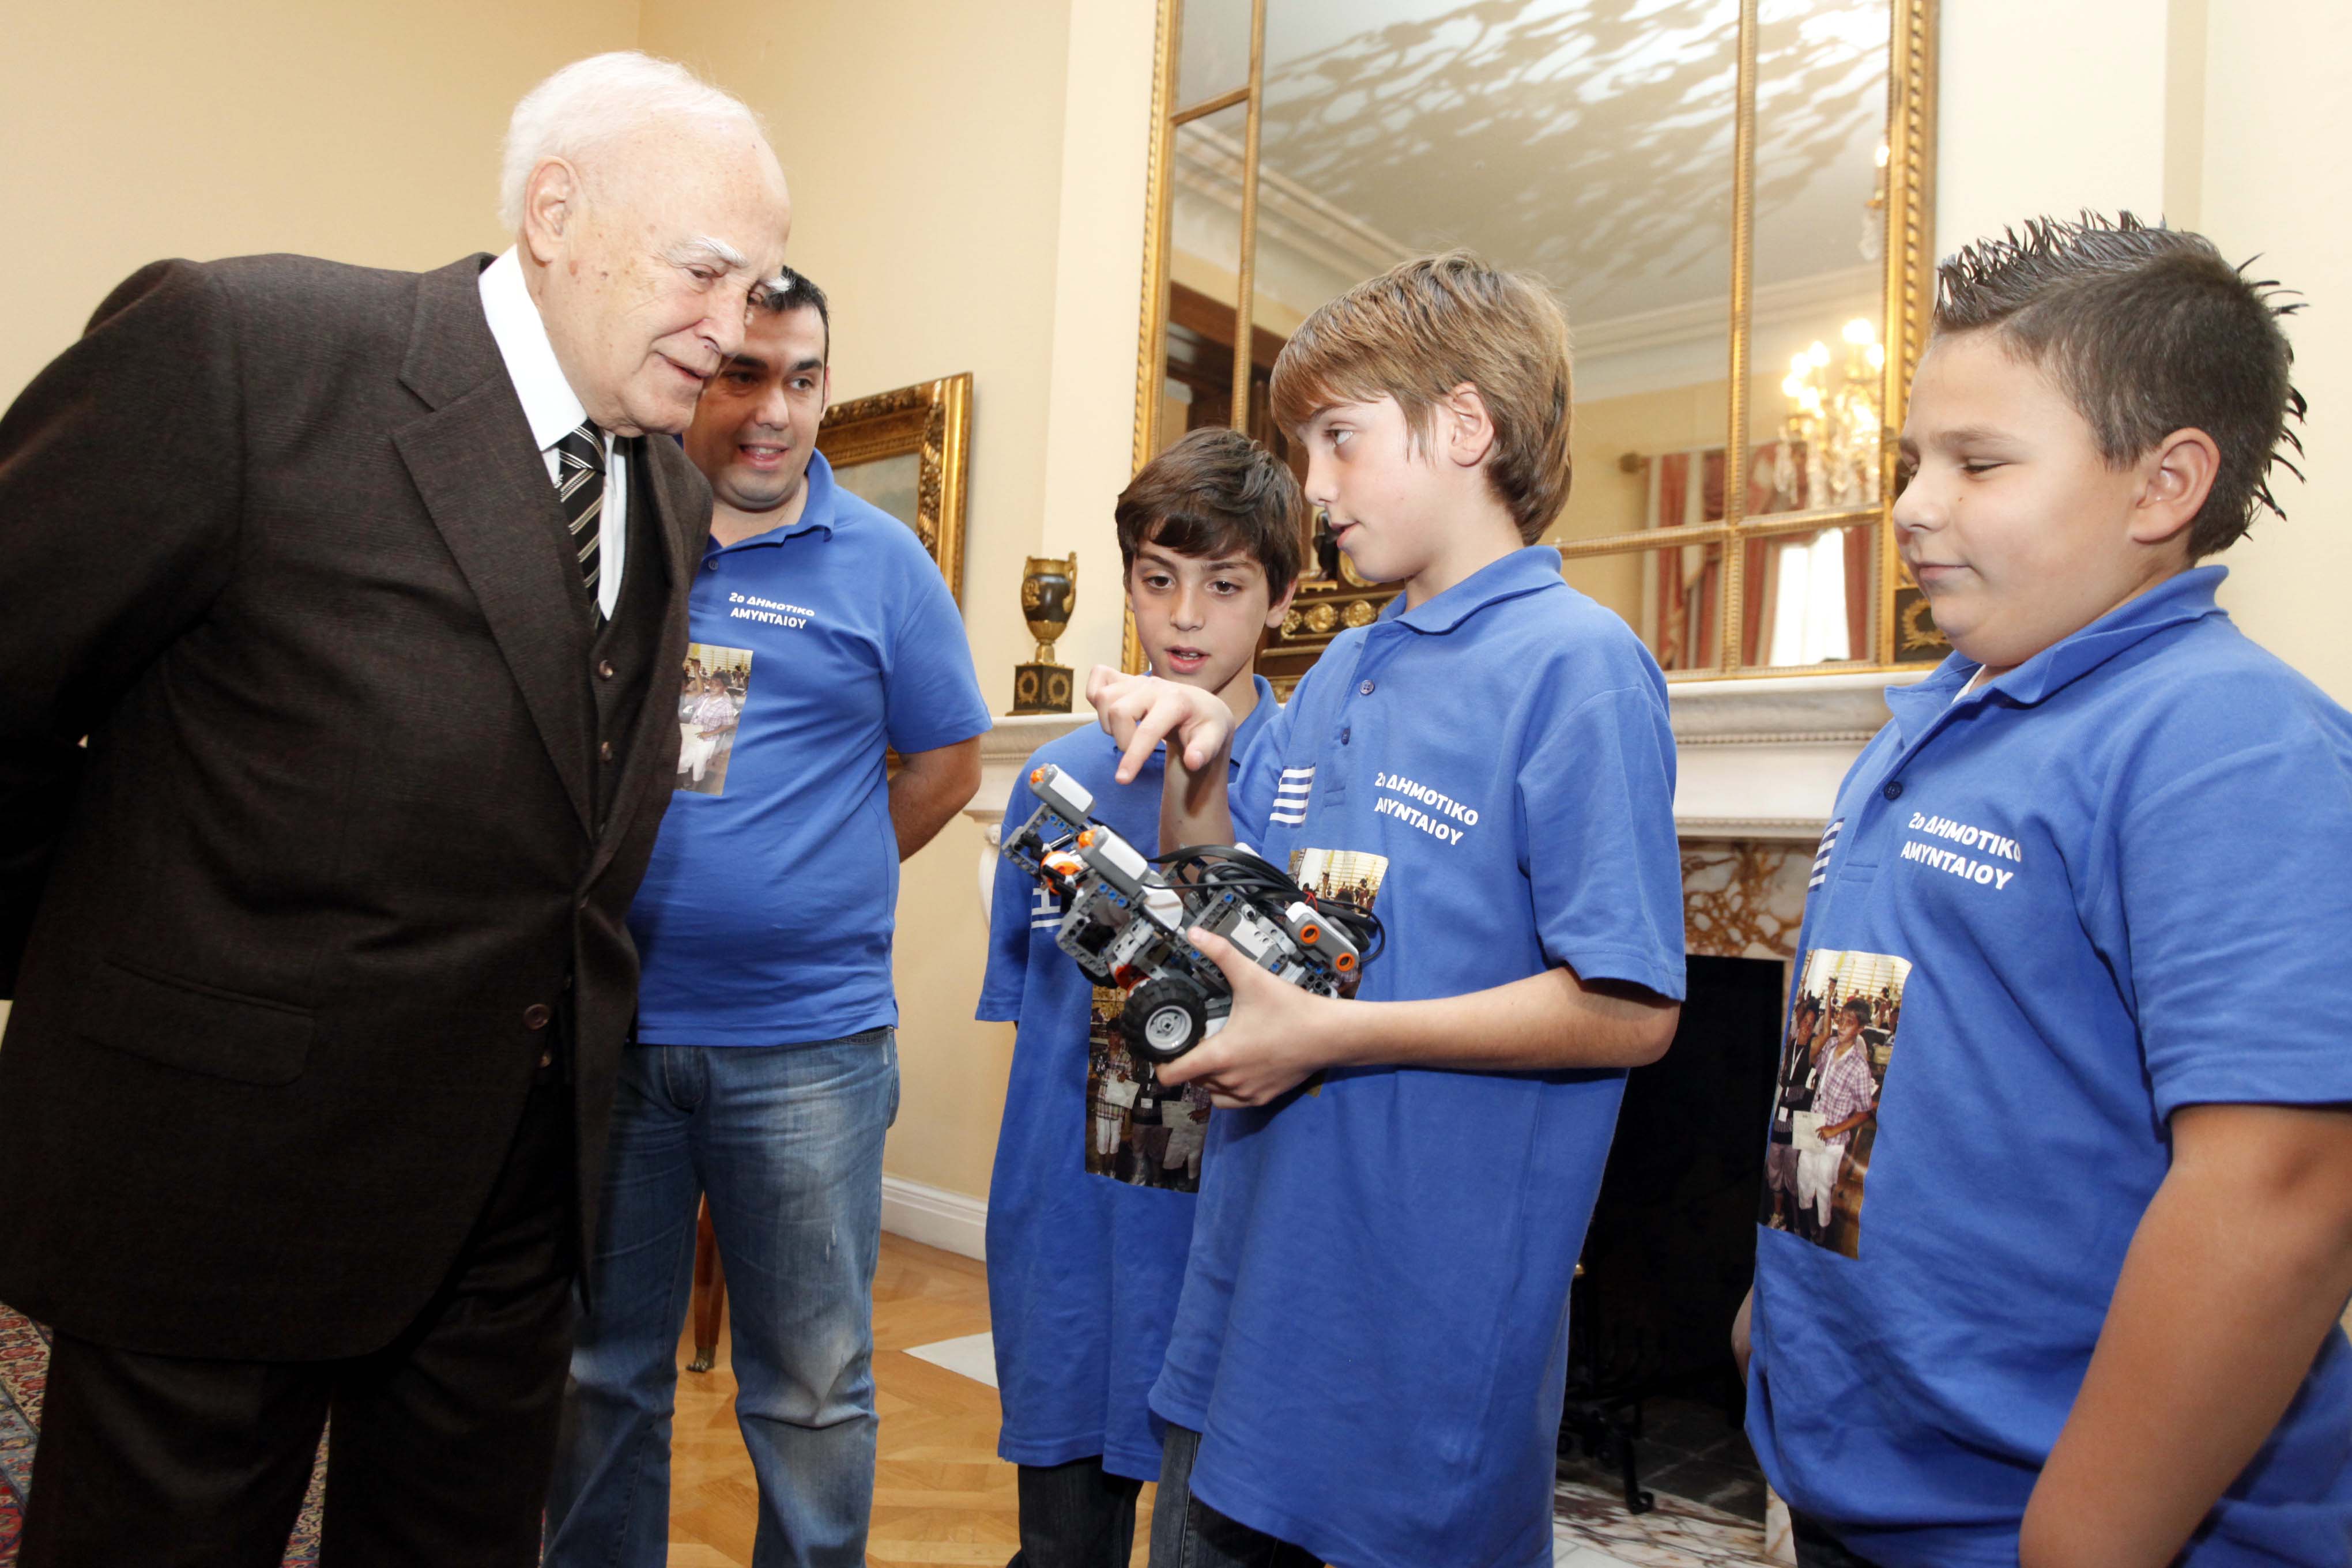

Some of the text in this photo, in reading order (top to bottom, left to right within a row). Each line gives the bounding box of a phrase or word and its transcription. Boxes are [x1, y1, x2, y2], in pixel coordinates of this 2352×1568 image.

[730, 607, 807, 630] ΑΜΥΝΤΑΙΟΥ
[746, 595, 816, 617] ΔΗΜΟΤΙΚΟ
[1385, 774, 1479, 826] ΔΗΜΟΤΙΚΟ
[1900, 840, 2015, 891] ΑΜΥΝΤΑΙΟΥ
